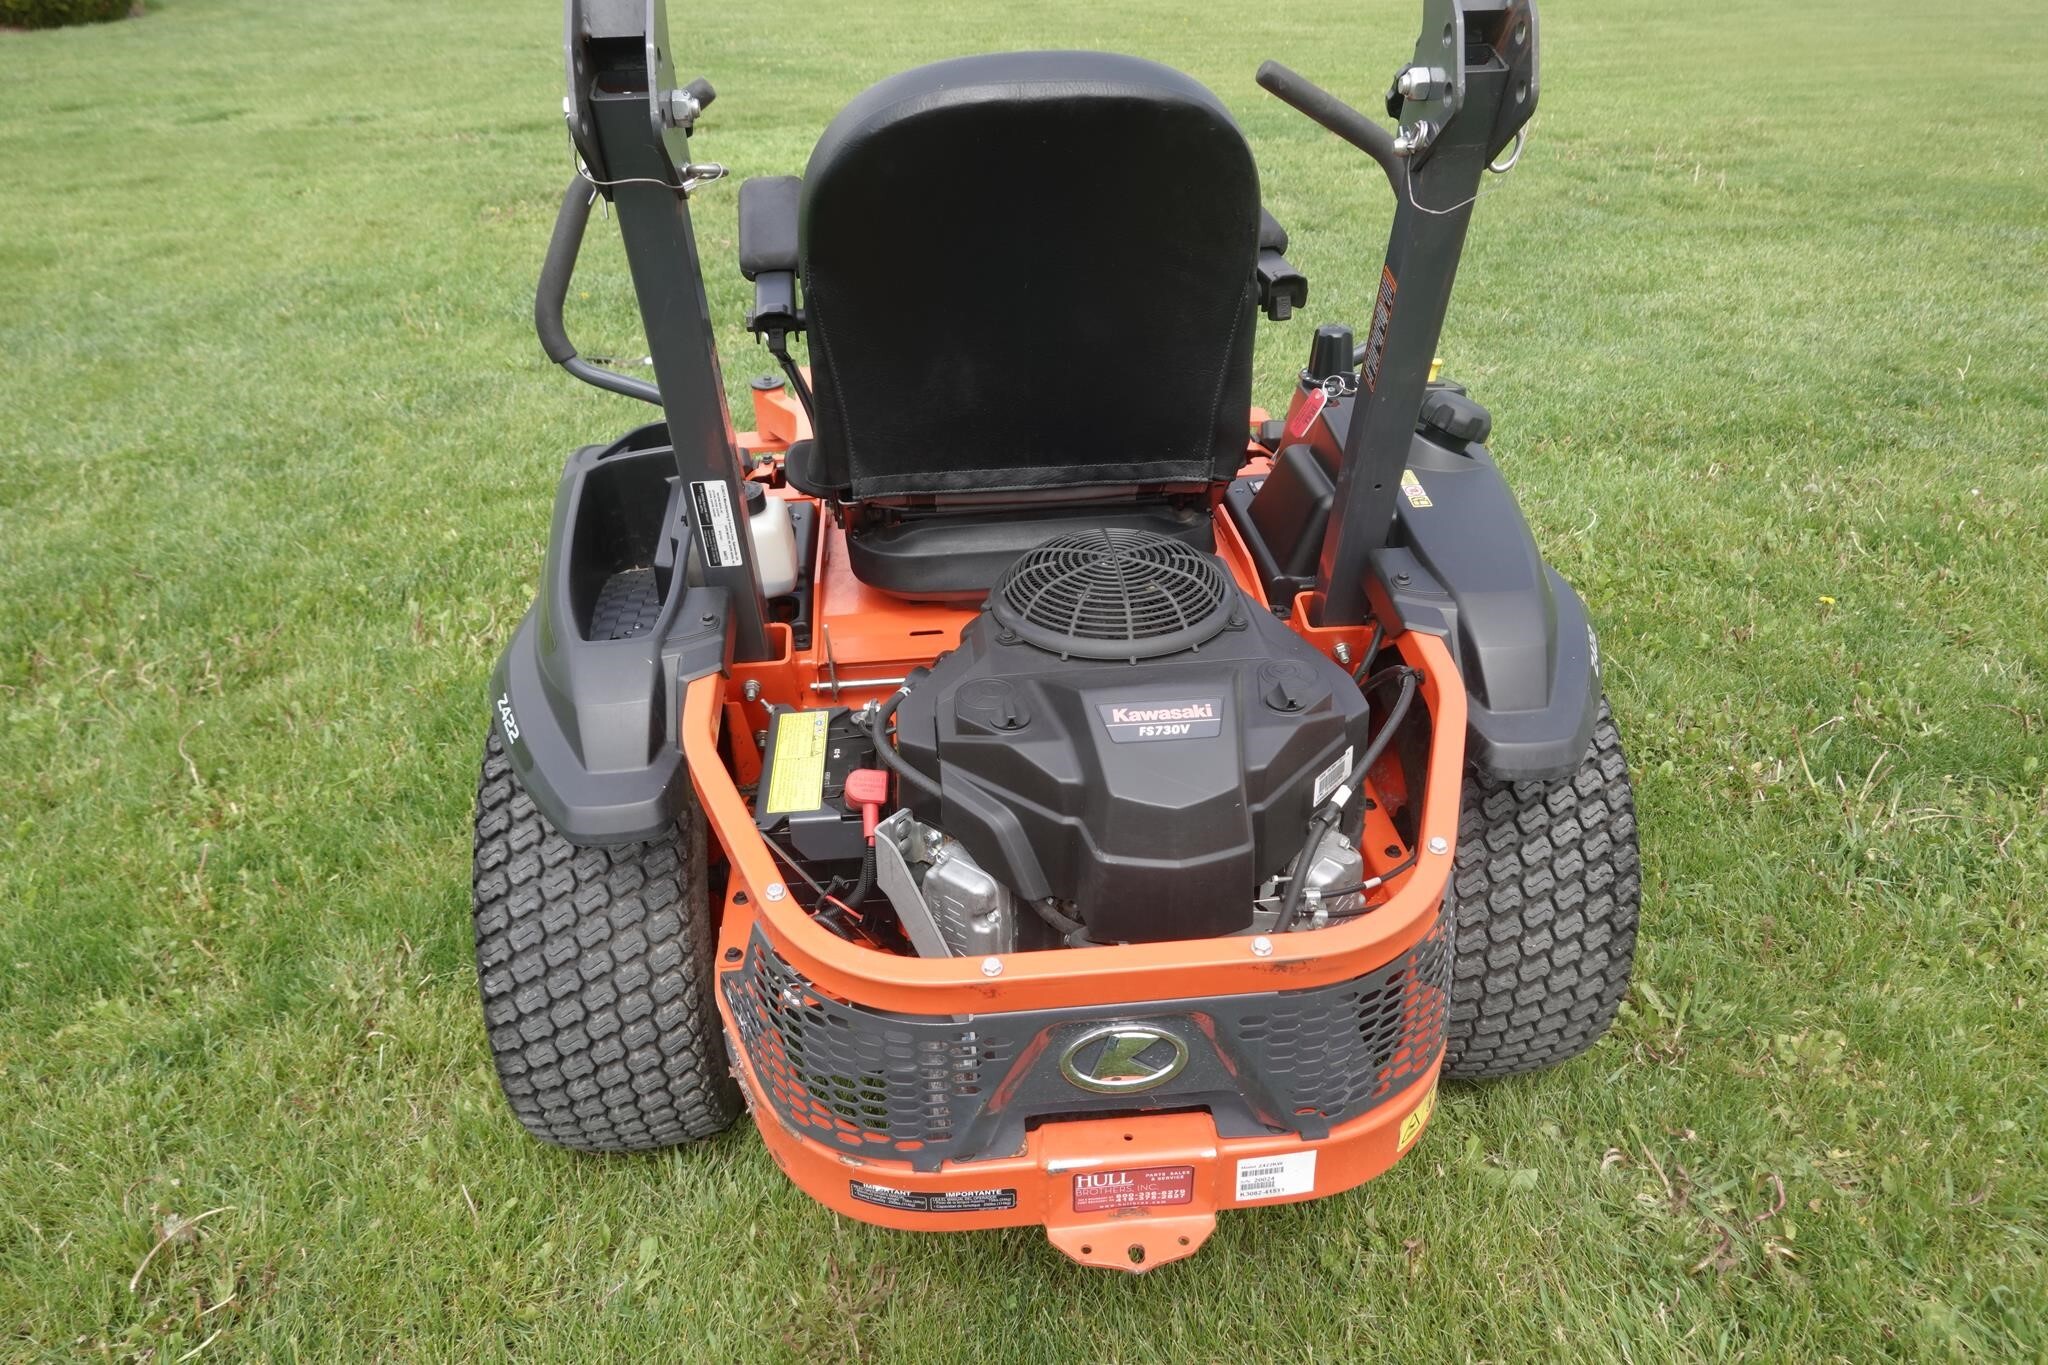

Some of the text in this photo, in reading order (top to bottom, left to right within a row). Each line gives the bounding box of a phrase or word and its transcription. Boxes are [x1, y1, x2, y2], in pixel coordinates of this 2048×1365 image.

[1112, 703, 1213, 723] Kawasaki
[1139, 723, 1191, 737] FS730V
[1076, 1172, 1134, 1188] HULL
[862, 1183, 912, 1197] IMPORTANT
[945, 1188, 1002, 1198] IMPORTANTE
